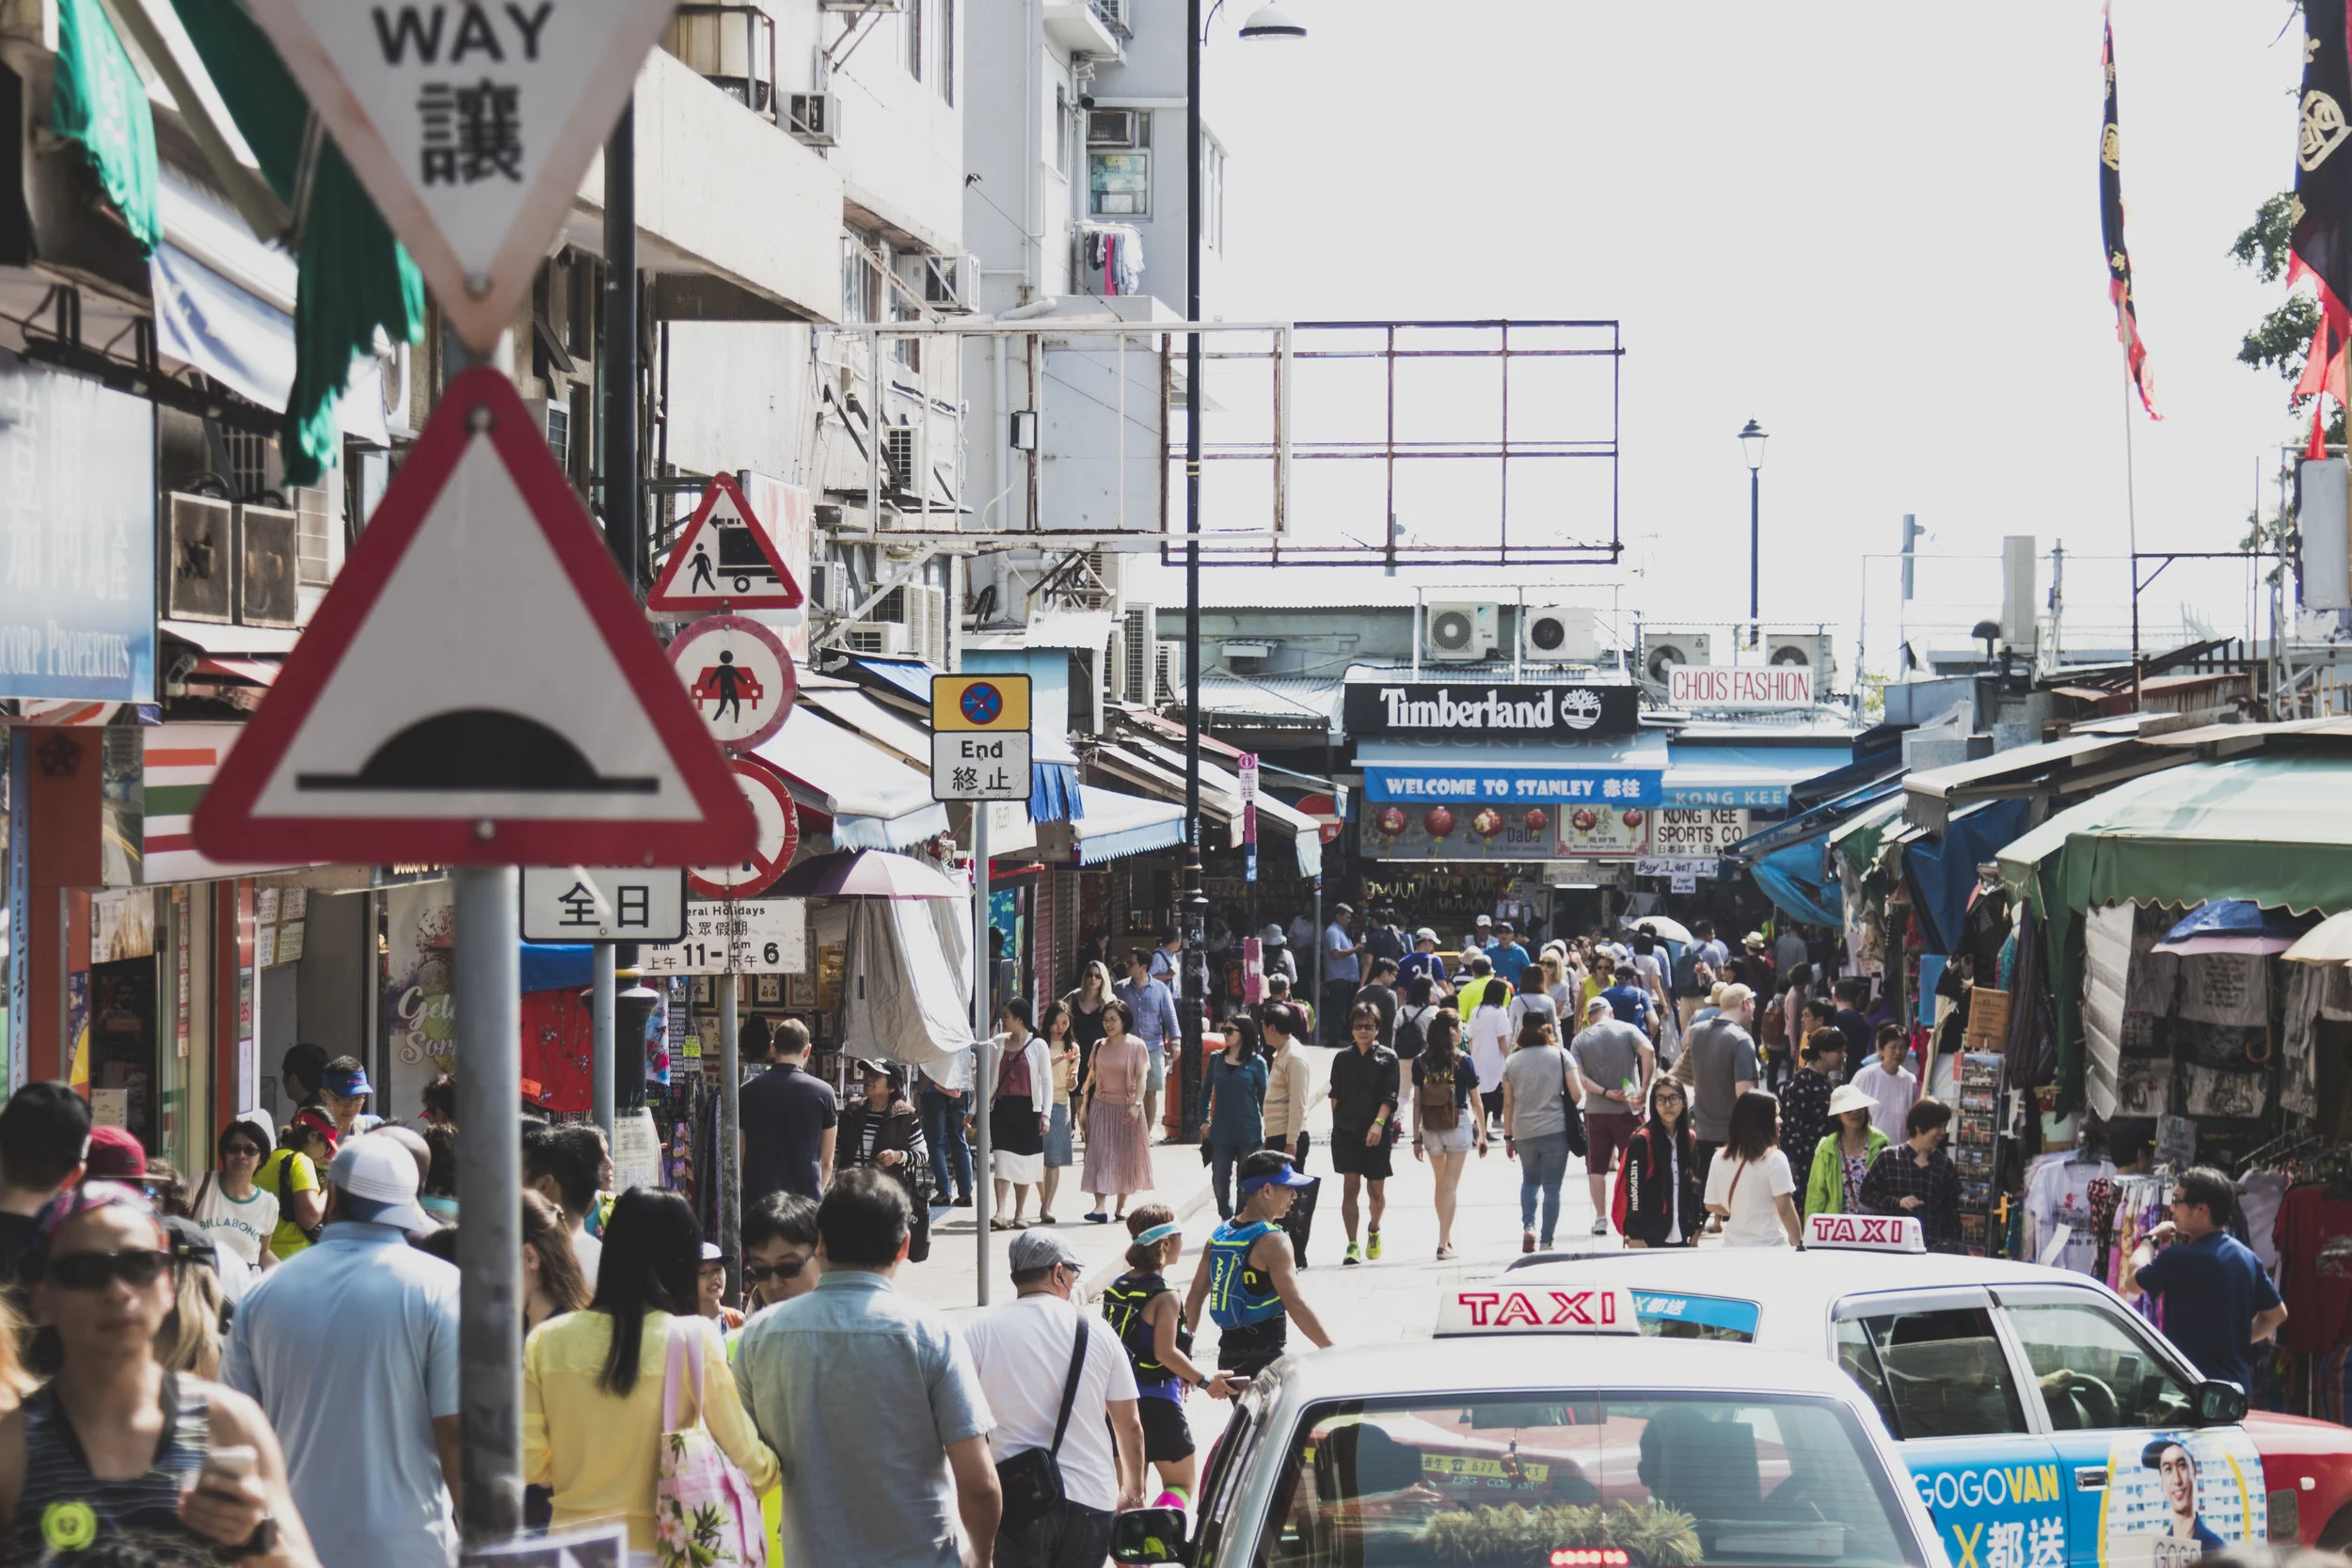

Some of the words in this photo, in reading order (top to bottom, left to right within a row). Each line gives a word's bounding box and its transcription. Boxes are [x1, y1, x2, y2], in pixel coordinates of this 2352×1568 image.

[372, 2, 554, 66] WAY
[417, 77, 523, 185] 讓
[0, 626, 41, 675] CORP
[1673, 671, 1728, 701] CHOI'S
[1734, 672, 1809, 702] FASHION
[1379, 688, 1554, 728] Timberland
[961, 740, 1003, 758] End
[952, 767, 1012, 792] 終止
[1386, 778, 1476, 797] WELCOME
[1483, 779, 1509, 796] TO
[1516, 779, 1595, 797] STANLEY
[1603, 779, 1640, 798] 赤柱
[1676, 792, 1734, 805] KONG
[1744, 790, 1783, 804] KEE
[1663, 809, 1702, 824] KONG
[1710, 809, 1738, 824] KEE
[1658, 826, 1713, 843] SPORTS
[1722, 826, 1743, 843] CO
[1638, 861, 1660, 875] Buy
[1675, 863, 1692, 873] GET
[557, 881, 649, 928] 全日
[686, 906, 708, 916] eral
[713, 905, 766, 917] Holidays
[686, 921, 748, 937] 公眾假期
[647, 956, 677, 971] 上午
[763, 942, 780, 965] 6
[1813, 1217, 1903, 1243] TAXI
[1458, 1291, 1616, 1326] TAXI
[1486, 1478, 1542, 1491] COMORT
[1912, 1465, 2059, 1509] GOGOVAN
